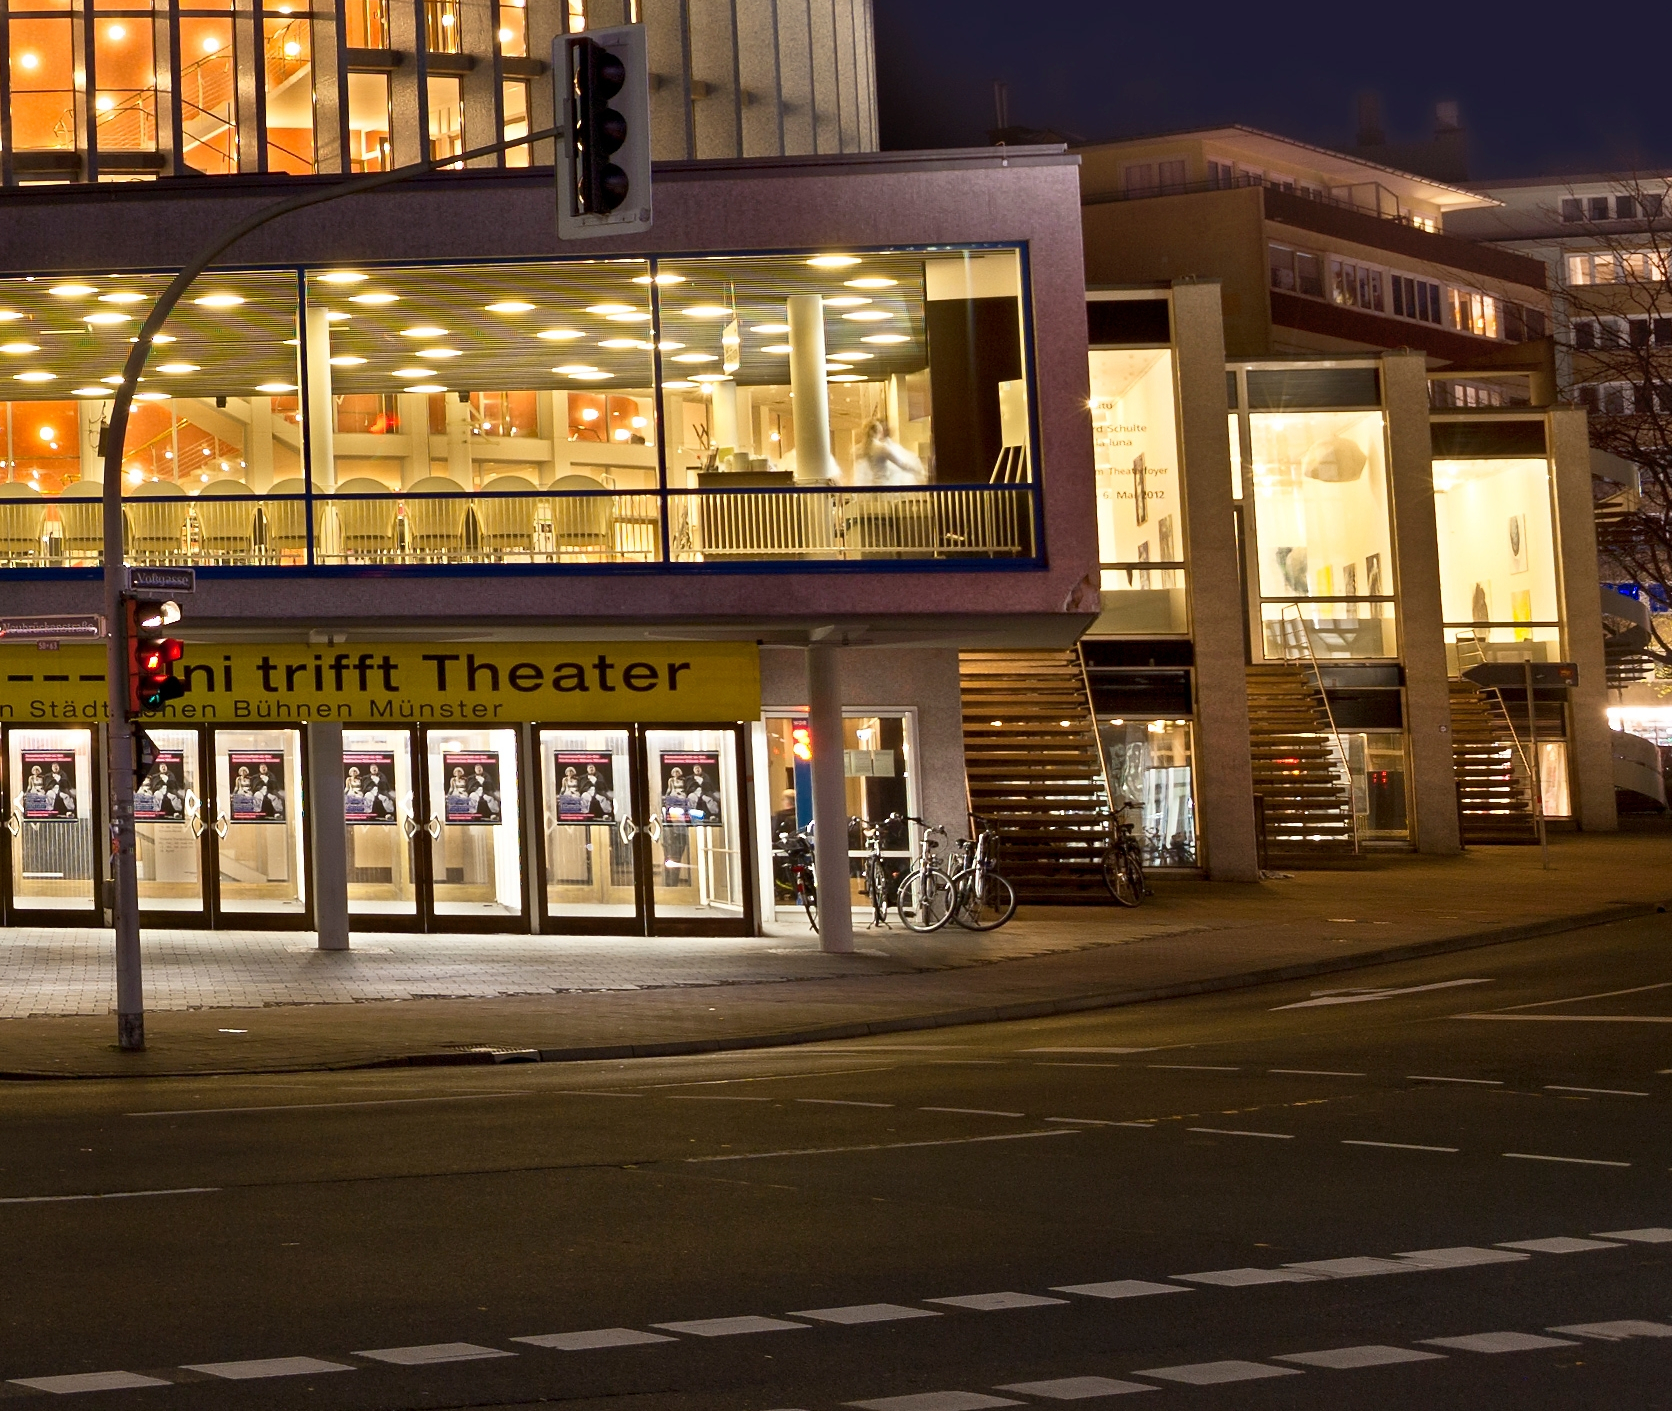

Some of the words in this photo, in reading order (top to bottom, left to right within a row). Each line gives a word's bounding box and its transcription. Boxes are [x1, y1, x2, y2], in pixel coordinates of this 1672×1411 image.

[1106, 424, 1147, 433] Schulte
[1143, 490, 1165, 499] 2012
[137, 572, 189, 586] Voßgasse
[2, 620, 95, 634] Neubrückenstraße
[164, 655, 233, 692] ni
[256, 654, 400, 692] trifft
[422, 654, 691, 692] Theater
[234, 699, 352, 718] Bühnen
[370, 699, 504, 718] Münster
